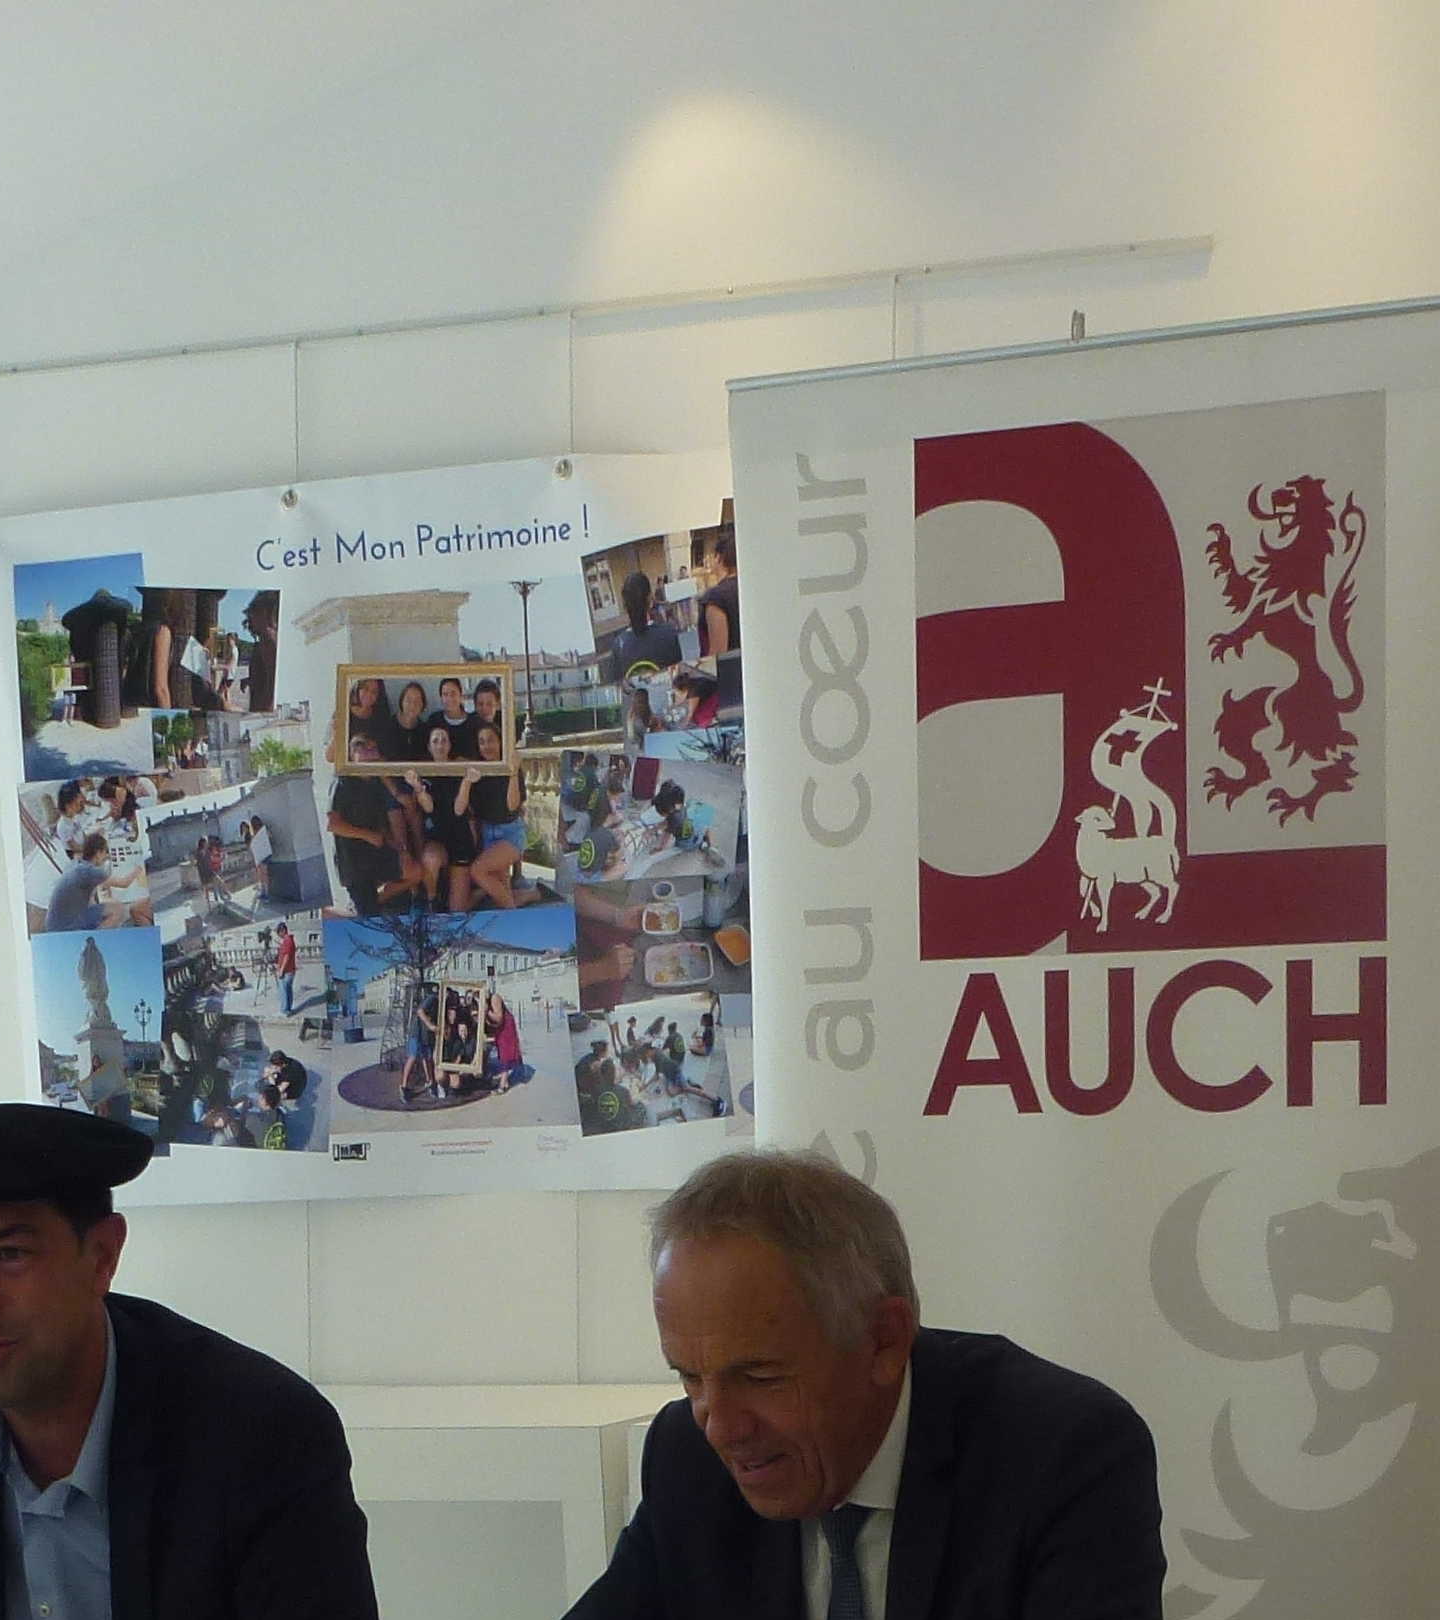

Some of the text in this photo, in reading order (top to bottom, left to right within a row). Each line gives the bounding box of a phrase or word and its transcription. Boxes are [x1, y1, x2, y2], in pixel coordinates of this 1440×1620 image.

[256, 503, 590, 570] C'est Mon Patrimoine !
[796, 451, 872, 849] cœur
[803, 906, 876, 1073] au
[923, 956, 1388, 1117] AUCH
